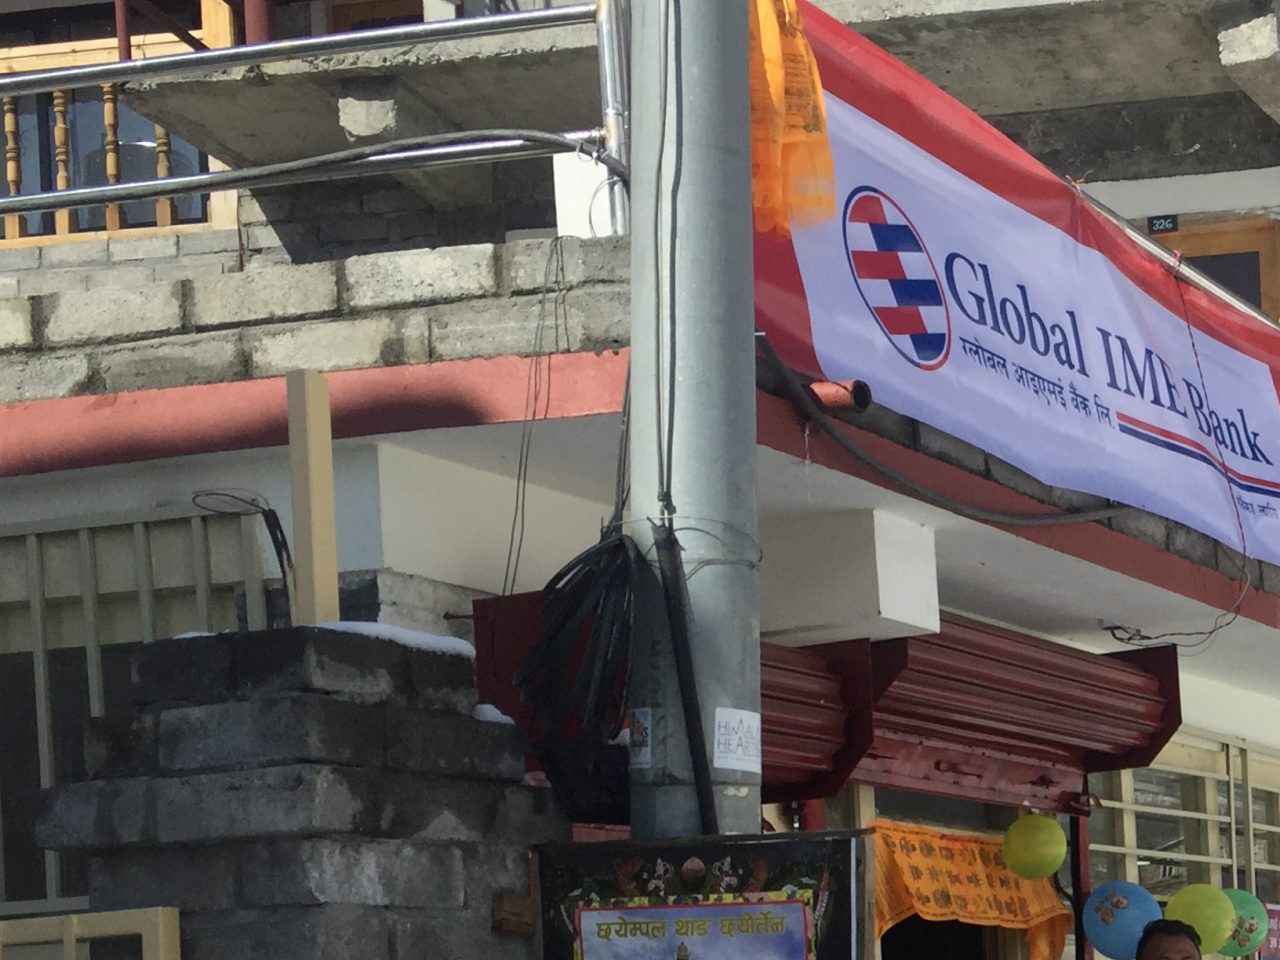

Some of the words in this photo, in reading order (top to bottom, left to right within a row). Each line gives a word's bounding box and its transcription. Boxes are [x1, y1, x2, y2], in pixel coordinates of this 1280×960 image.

[1152, 219, 1173, 231] 326
[944, 252, 1089, 377] Global
[1096, 327, 1188, 418] IME
[1183, 377, 1274, 466] Bank
